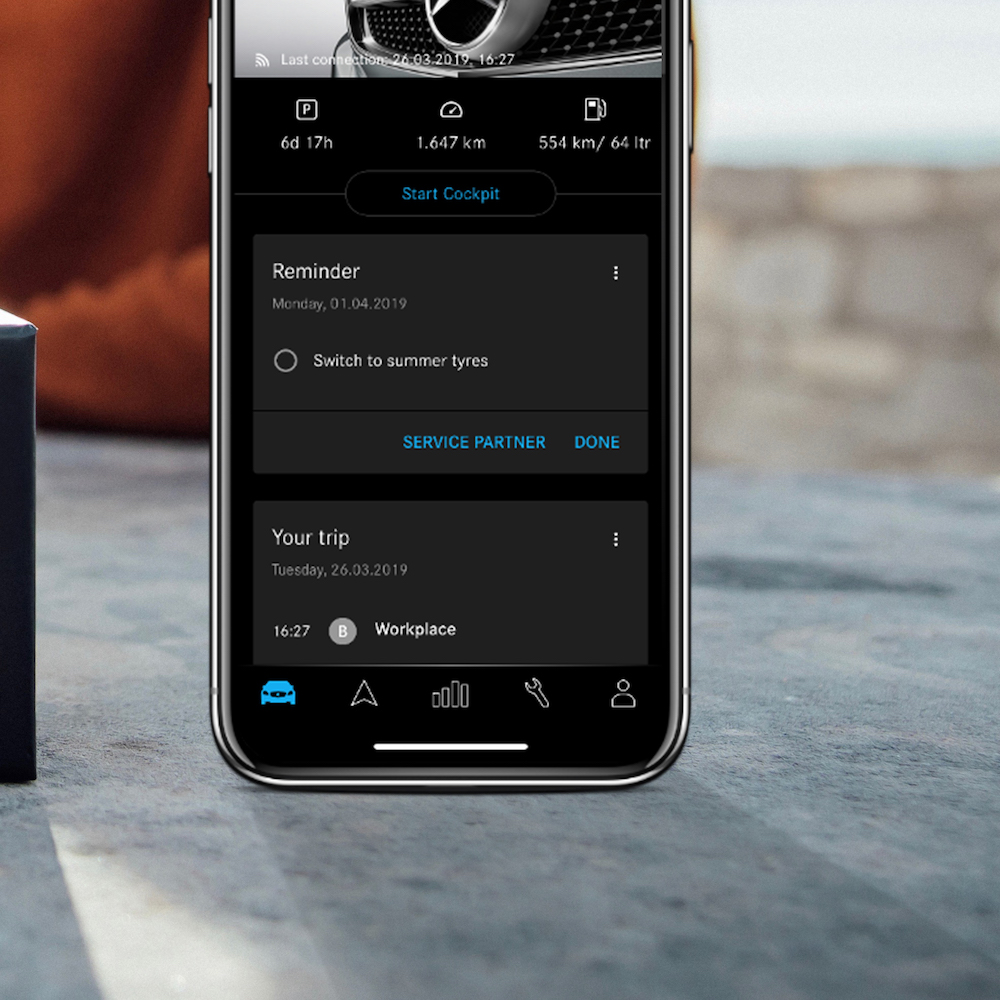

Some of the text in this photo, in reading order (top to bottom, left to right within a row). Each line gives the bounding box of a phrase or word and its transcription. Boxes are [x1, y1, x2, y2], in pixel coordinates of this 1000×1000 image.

[280, 53, 308, 66] Last
[479, 53, 515, 66] 16:27
[302, 103, 311, 115] P
[280, 135, 333, 150] 6d 17h
[418, 135, 486, 150] 1.647 km
[539, 135, 652, 152] 554 km/ 64 ltr
[401, 186, 500, 204] Start Cockpit
[273, 262, 361, 280] Reminder
[272, 297, 408, 313] Monday, 01.04.2019
[313, 353, 489, 372] Switch to summer tyres
[402, 434, 546, 449] SERVICE PARTNER
[574, 434, 620, 449] DONE
[271, 528, 350, 550] Your trip
[271, 562, 408, 580] Tuesday, 26.03.2019
[274, 624, 311, 638] 16:27
[338, 624, 349, 638] B
[374, 621, 457, 639] Workplace
